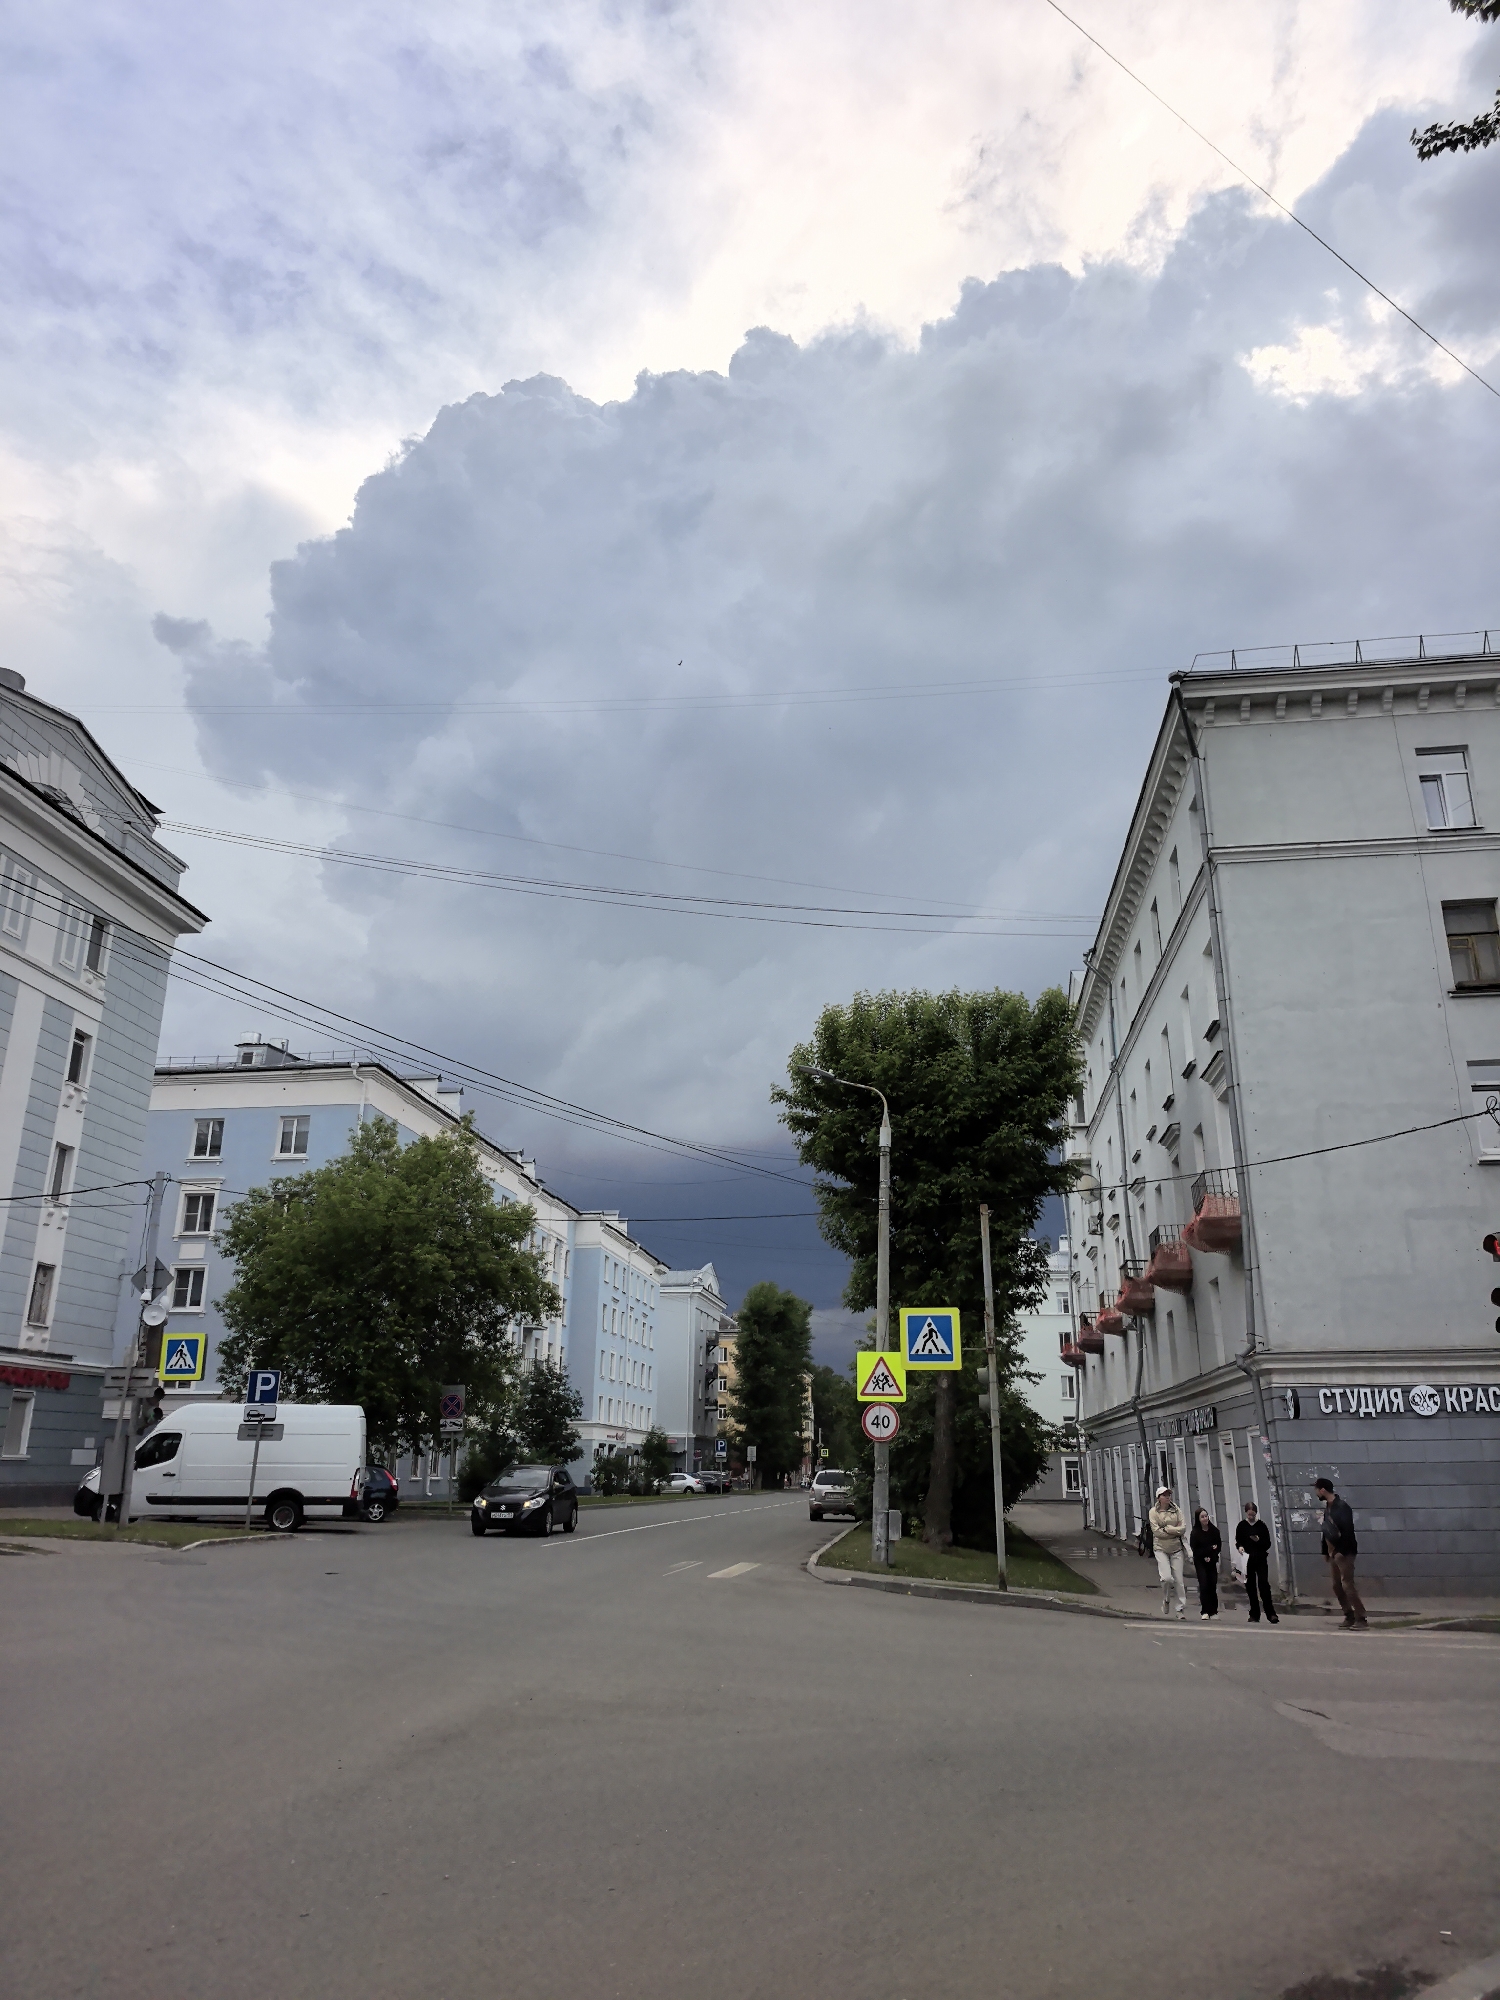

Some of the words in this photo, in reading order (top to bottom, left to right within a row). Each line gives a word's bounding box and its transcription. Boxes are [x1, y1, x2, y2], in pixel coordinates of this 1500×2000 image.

[255, 1373, 275, 1401] P
[1319, 1387, 1404, 1417] СТУДИЯ
[1444, 1386, 1500, 1412] КРАС
[871, 1415, 890, 1428] 40
[717, 1440, 725, 1450] P
